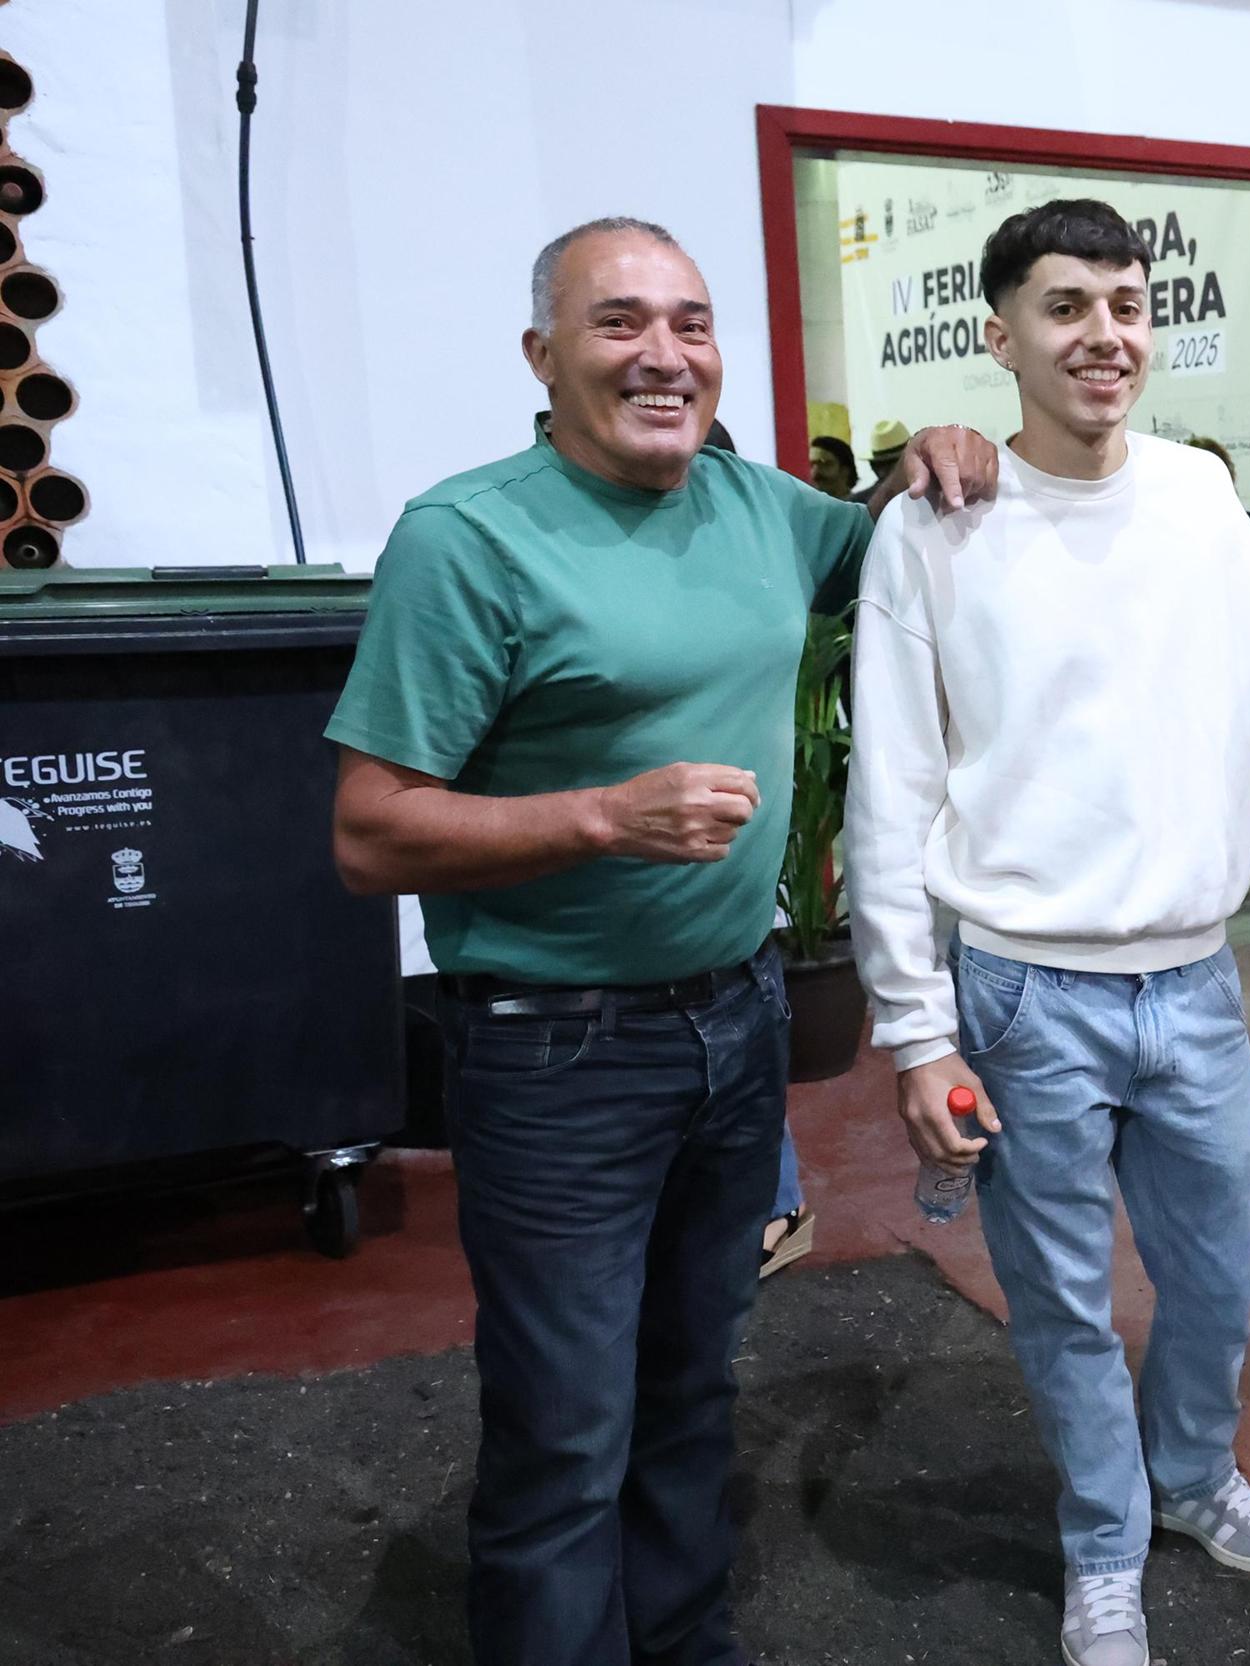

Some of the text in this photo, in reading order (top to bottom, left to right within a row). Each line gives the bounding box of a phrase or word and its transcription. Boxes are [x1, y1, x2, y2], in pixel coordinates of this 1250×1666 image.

[892, 210, 1197, 316] IV FERI RA,
[881, 270, 1227, 369] AGRÍCOL ERA
[1170, 332, 1221, 371] 2025
[0, 749, 148, 788] EGUISE
[50, 788, 152, 804] Avanzamos Contigo
[57, 801, 152, 817] Progress with you
